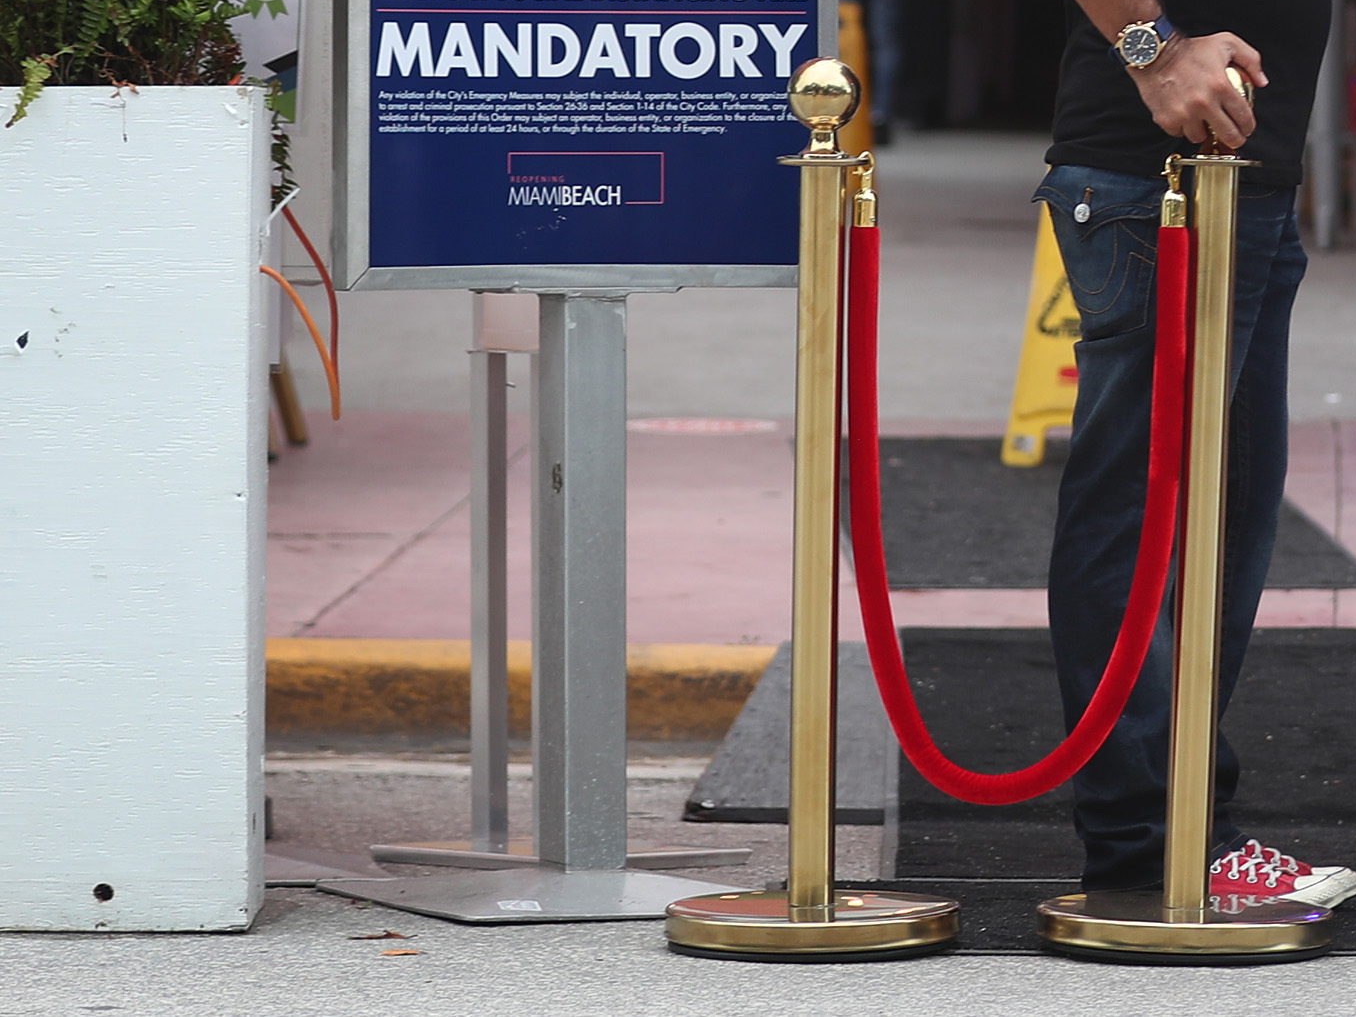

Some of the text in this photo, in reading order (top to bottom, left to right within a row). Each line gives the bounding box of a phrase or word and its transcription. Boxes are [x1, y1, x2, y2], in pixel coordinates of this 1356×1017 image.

[376, 22, 808, 79] MANDATORY
[378, 91, 393, 102] Any
[395, 91, 425, 100] violation
[436, 91, 446, 100] the
[447, 91, 468, 102] City's
[468, 91, 508, 102] Emergency
[508, 91, 544, 100] Measures
[545, 94, 561, 102] may
[562, 91, 588, 102] subject
[590, 91, 602, 100] the
[604, 91, 643, 102] individual,
[644, 91, 680, 102] operator,
[681, 91, 713, 100] business
[715, 91, 738, 102] entity,
[388, 101, 408, 110] arrest
[409, 101, 423, 110] and
[424, 101, 452, 110] criminal
[454, 101, 494, 112] prosecution
[496, 101, 526, 112] pursuant
[536, 101, 564, 110] Section
[564, 101, 588, 110] 26-36
[589, 101, 605, 110] and
[606, 101, 634, 110] Section
[636, 101, 654, 110] 1-14
[666, 101, 678, 110] the
[680, 101, 696, 112] City
[696, 101, 721, 110] Code.
[722, 101, 771, 112] Furthermore,
[772, 104, 788, 112] any
[378, 113, 409, 121] violation
[419, 113, 431, 121] the
[432, 113, 467, 123] provisions
[468, 113, 476, 121] of
[477, 113, 490, 121] this
[490, 113, 513, 121] Order
[514, 115, 530, 123] may
[532, 113, 558, 123] subject
[570, 113, 604, 123] operator,
[604, 113, 637, 121] business
[638, 113, 662, 123] entity,
[674, 113, 723, 123] organization
[734, 113, 746, 121] the
[748, 113, 776, 121] closure
[378, 124, 728, 134] establishment for period least 24 hours, through the duration the State Emergency.
[508, 185, 621, 205] MIAMIBEACH
